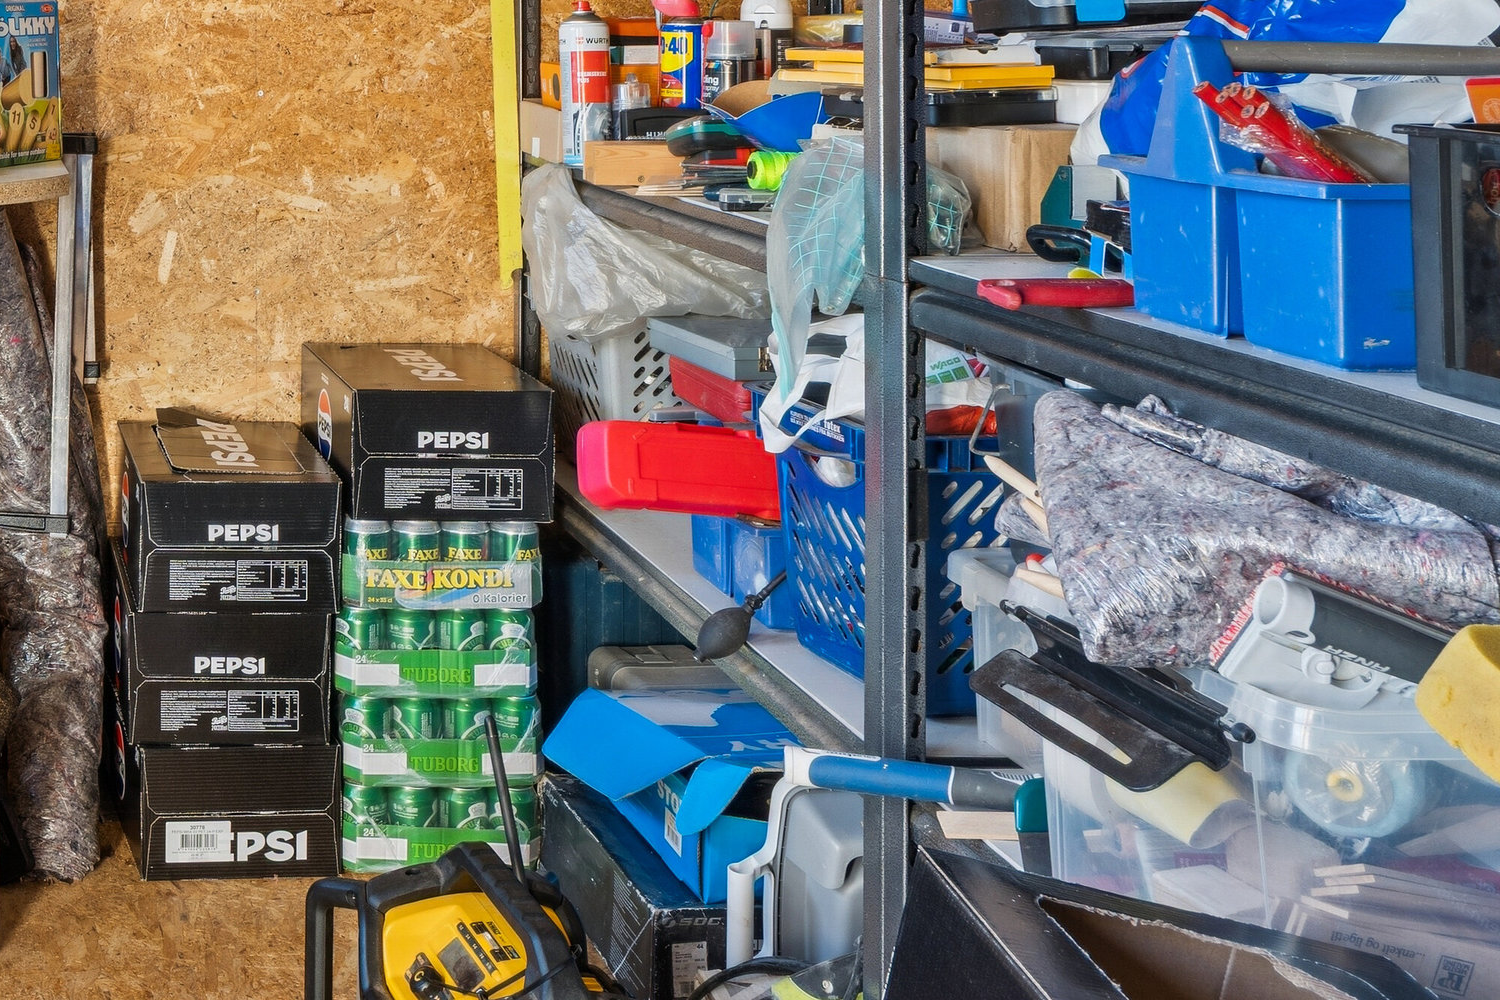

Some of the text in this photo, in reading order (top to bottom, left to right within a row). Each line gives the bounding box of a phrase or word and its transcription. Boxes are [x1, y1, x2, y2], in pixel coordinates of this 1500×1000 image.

[12, 111, 21, 125] 11
[29, 117, 37, 130] 5
[384, 349, 464, 382] PEPSI
[930, 356, 961, 370] WAGO
[196, 418, 260, 468] PEPSI
[418, 431, 489, 449] PEPSI
[208, 524, 280, 542] PEPSI
[408, 548, 440, 561] FAXE
[448, 547, 481, 561] FAXE
[366, 568, 513, 590] FAXE KONDI
[473, 593, 526, 603] 0 Kalorier
[194, 656, 265, 674] PEPSI
[355, 655, 366, 664] 24
[403, 667, 472, 684] TUBORG
[363, 744, 375, 752] 24
[410, 756, 479, 773] TUBORG
[363, 828, 374, 837] 24
[230, 830, 308, 862] PSI
[413, 843, 454, 859] TUB
[1367, 938, 1379, 949] og
